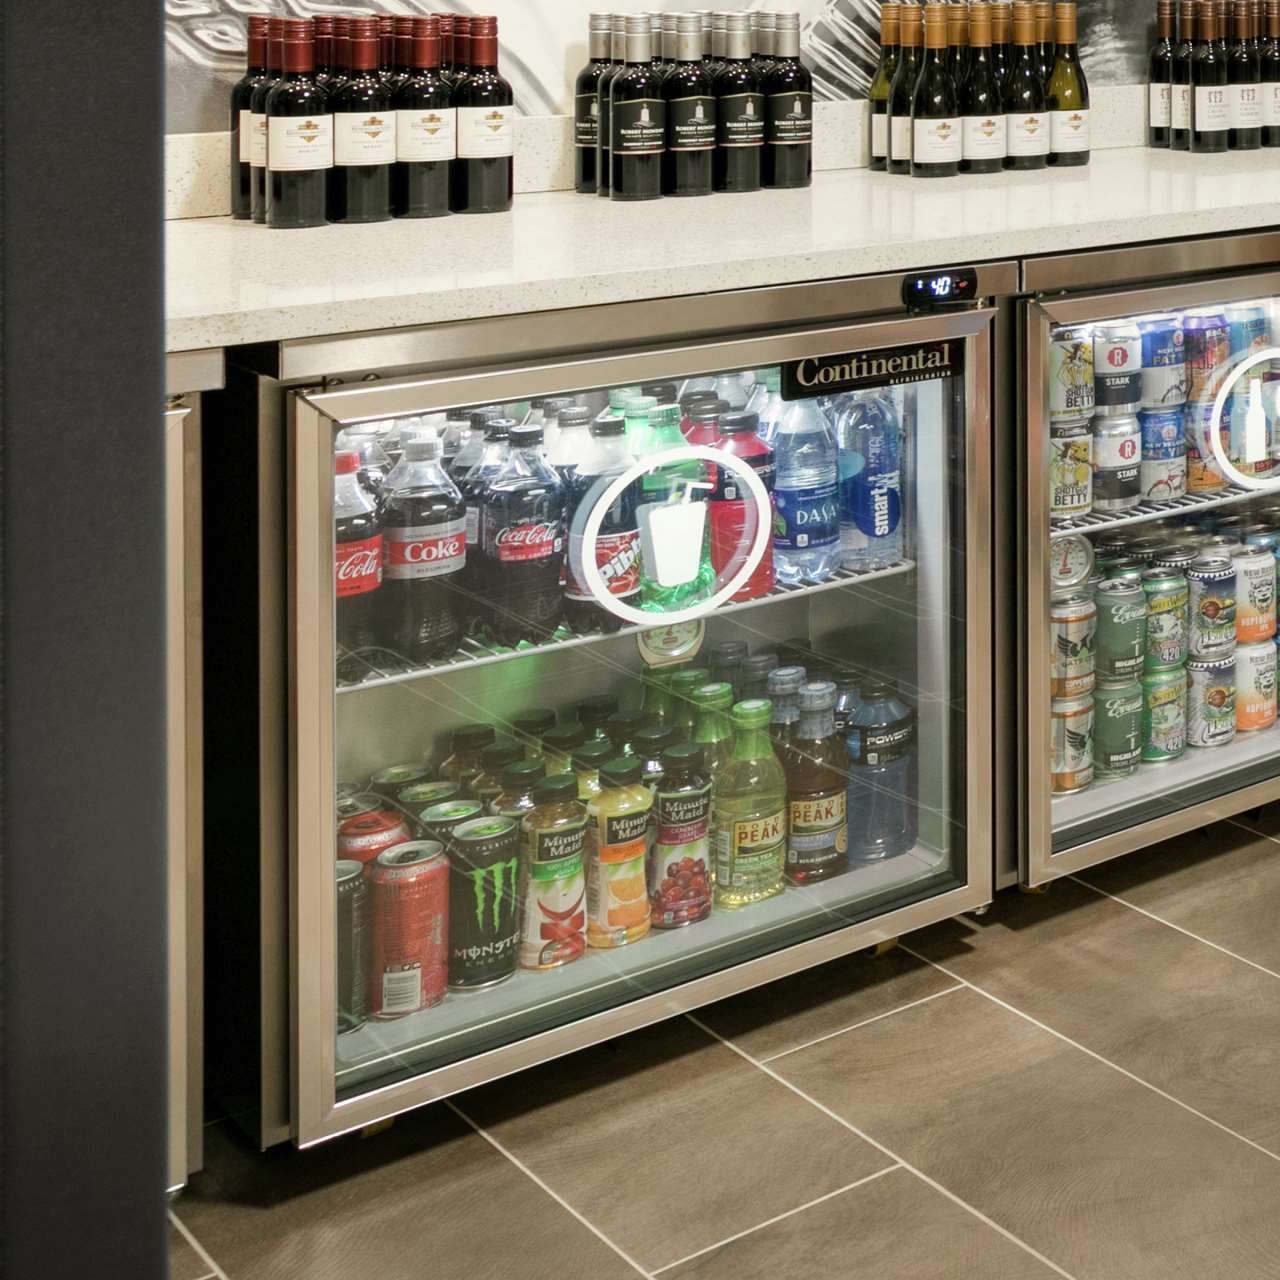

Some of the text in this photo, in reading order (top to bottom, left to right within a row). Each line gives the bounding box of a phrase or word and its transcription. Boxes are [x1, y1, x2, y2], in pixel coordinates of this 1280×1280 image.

[795, 343, 951, 389] Continental
[1105, 376, 1130, 386] STARK
[1116, 469, 1138, 478] STARK
[1054, 494, 1088, 506] BETTY
[796, 503, 839, 525] DASA
[495, 521, 557, 547] Coca-Cola
[404, 540, 459, 562] Coke
[793, 805, 834, 824] PEAK
[738, 822, 780, 844] PEAK
[453, 933, 520, 960] MONSTE
